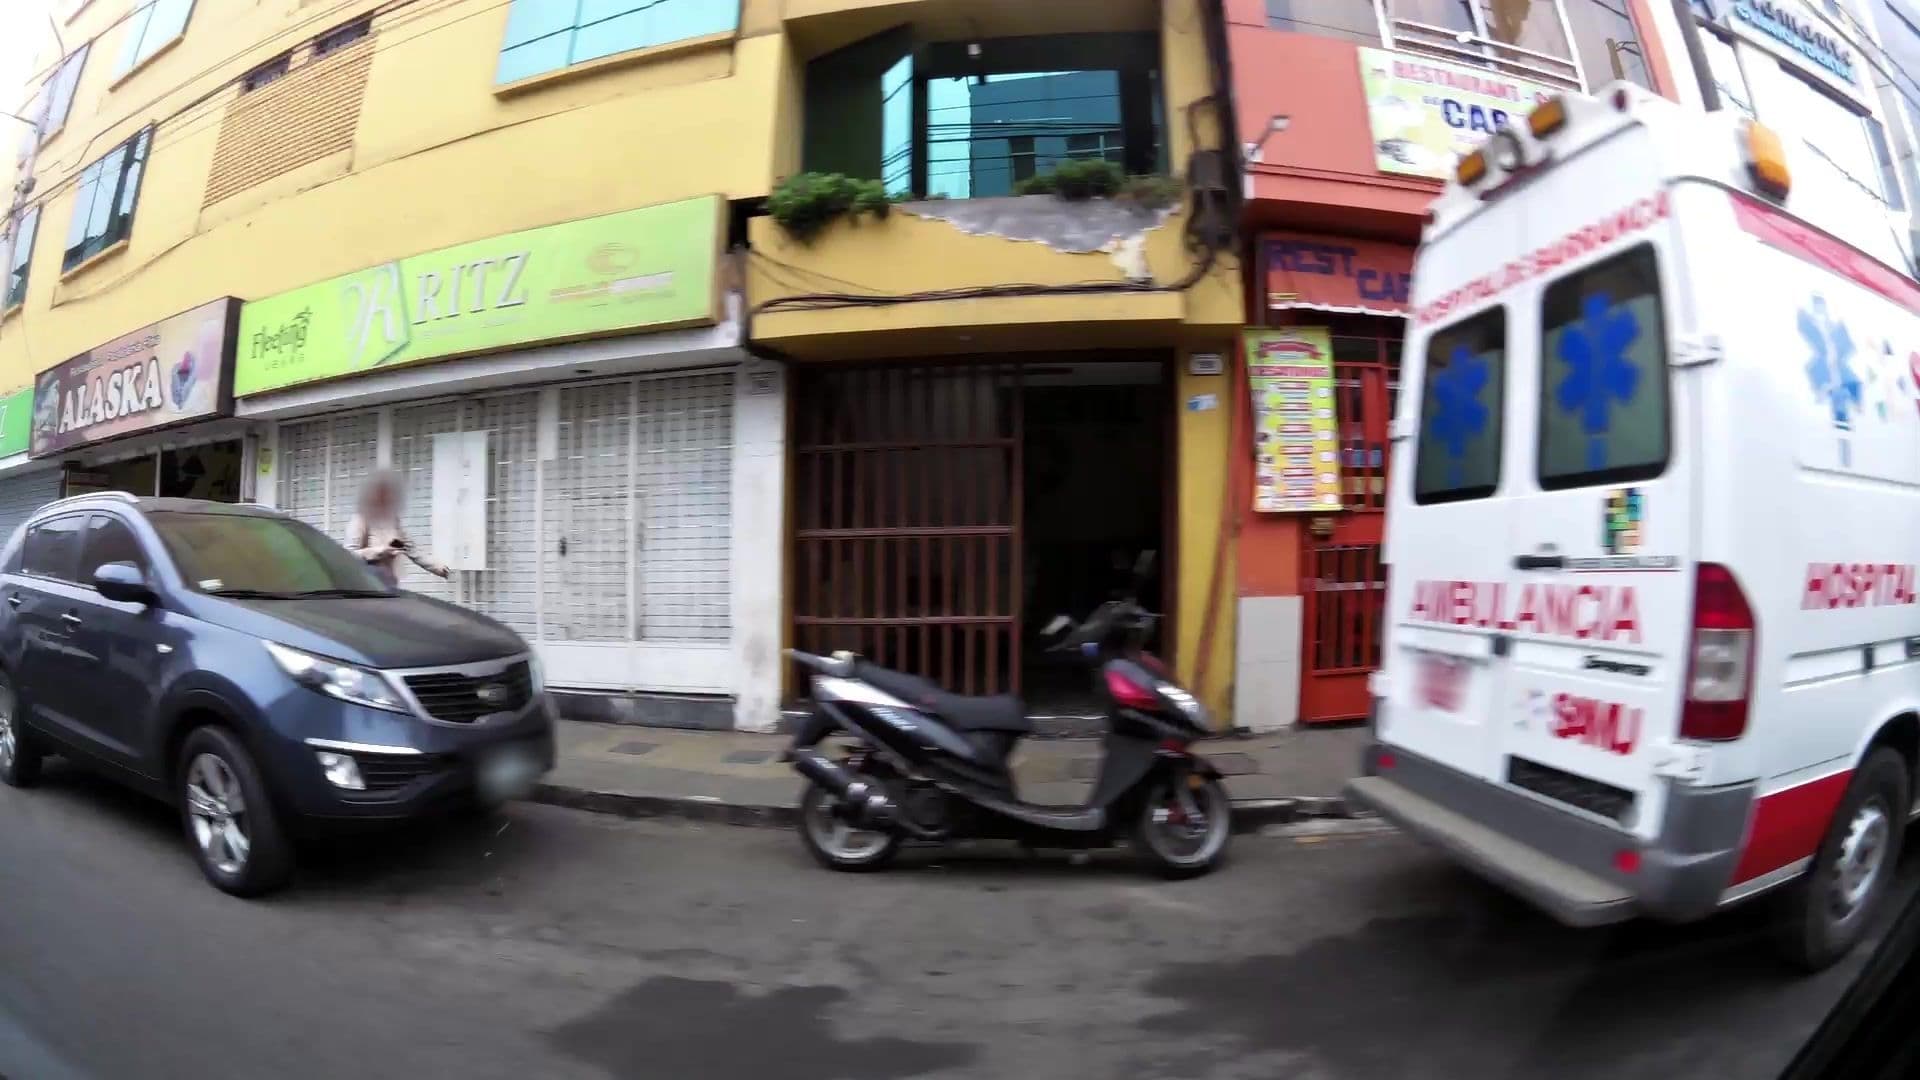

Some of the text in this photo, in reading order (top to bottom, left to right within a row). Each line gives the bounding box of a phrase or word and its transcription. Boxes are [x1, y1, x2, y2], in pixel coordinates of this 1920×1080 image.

[1264, 239, 1358, 277] REST
[58, 355, 163, 434] ALASKA
[1410, 579, 1642, 644] AMBULANCIA
[1801, 562, 1915, 610] HOSPITAL
[1547, 692, 1642, 754] SAMU
